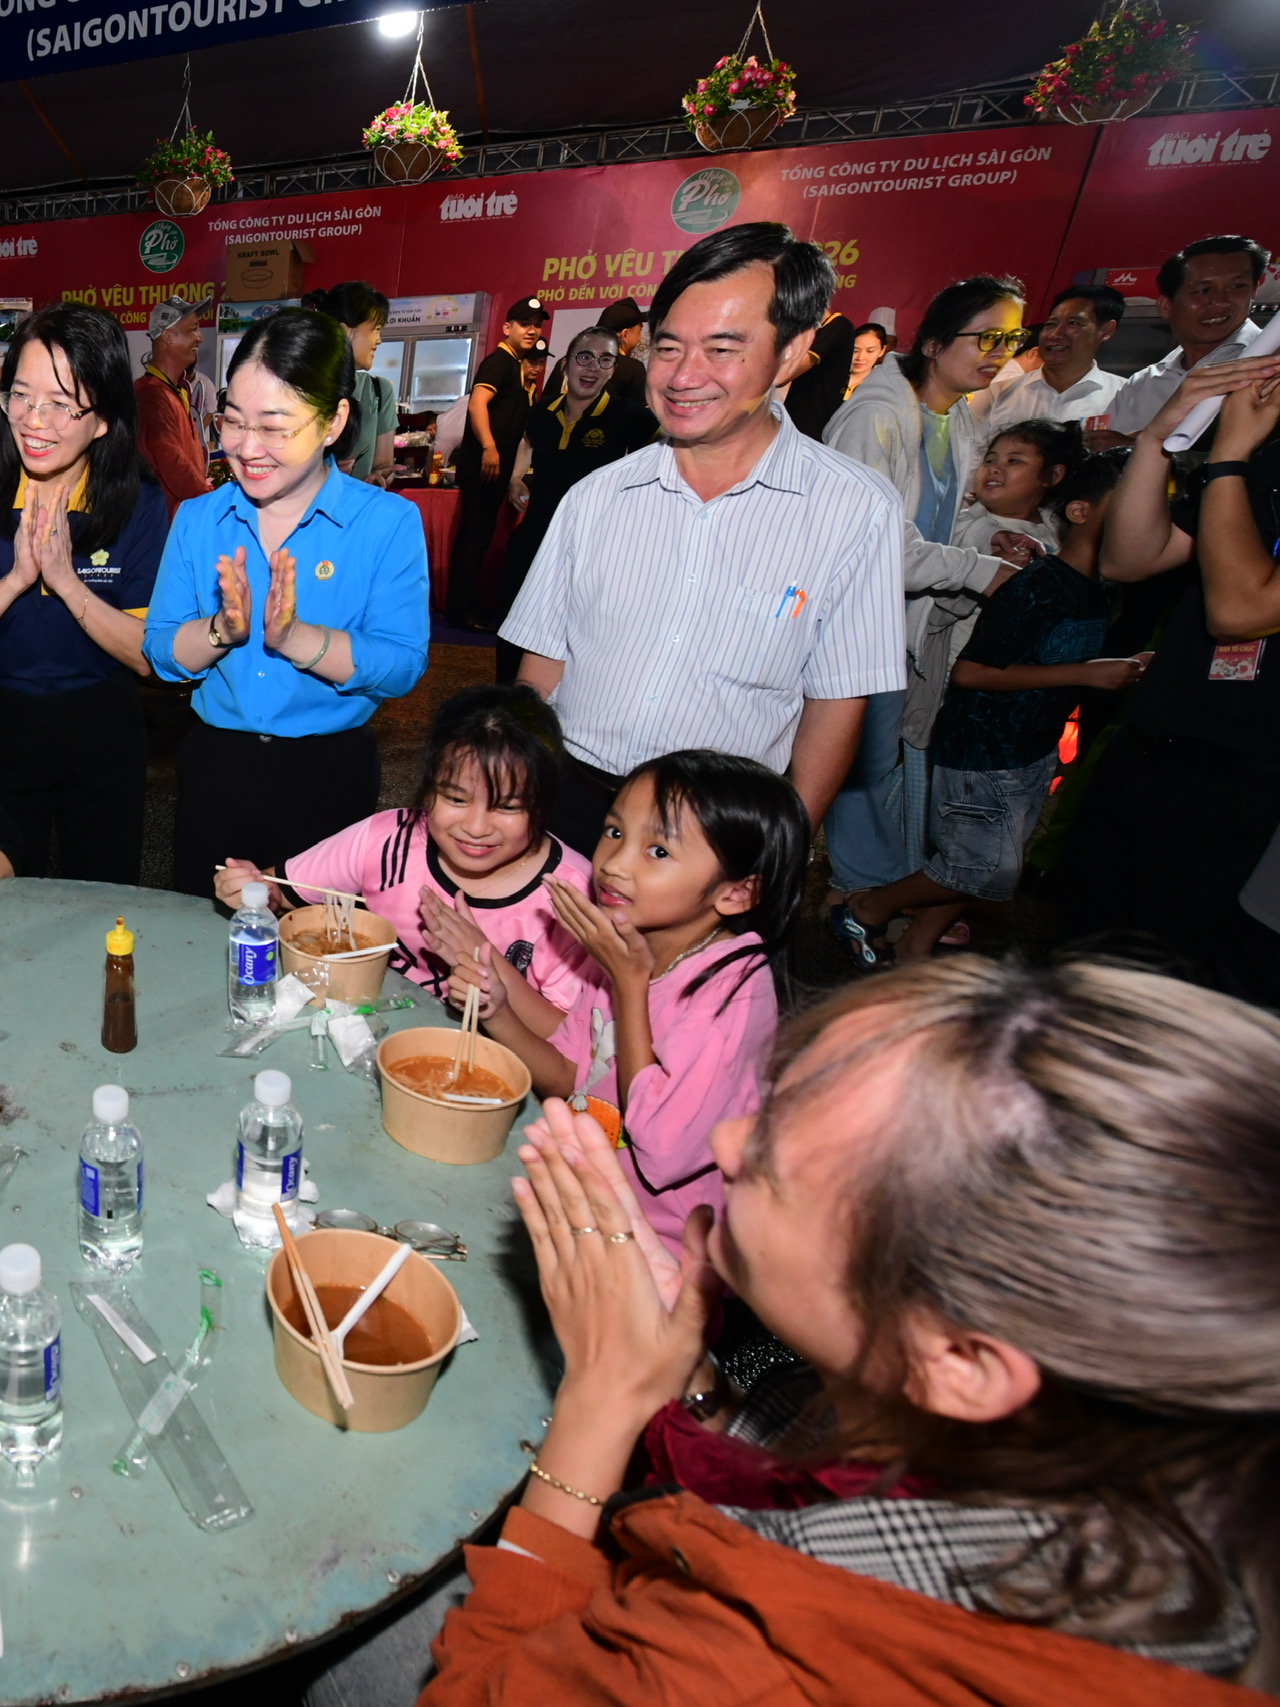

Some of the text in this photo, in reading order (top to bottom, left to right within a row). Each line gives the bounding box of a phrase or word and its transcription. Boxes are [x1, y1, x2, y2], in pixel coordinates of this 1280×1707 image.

[1148, 127, 1271, 166] tuổi trẻ
[781, 145, 1052, 181] TỔNG CÔNG TY DU LỊCH SÀI GÒN
[677, 179, 733, 212] Phở
[802, 169, 1018, 199] (SAIGONTOURIST GROUP)
[208, 204, 382, 232] TỔNG CÔNG TY DU LỊCH SÀI GÒN
[439, 190, 518, 220] tuổi trẻ
[16, 236, 38, 256] trẻ
[144, 230, 179, 254] Phở
[224, 224, 362, 246] (SAIGONTOURIST GROUP)
[260, 249, 279, 257] BOWL
[543, 249, 597, 281] PHỞ
[605, 248, 654, 278] YÊU
[101, 283, 134, 307] YÊU
[139, 280, 215, 304] THƯƠNG
[537, 285, 565, 302] PHỞ
[600, 283, 624, 299] VỚI
[627, 281, 659, 297] CÔN
[120, 310, 147, 324] CÔNG
[397, 314, 421, 323] KHUẨN
[243, 946, 257, 985] Ocany
[286, 1157, 297, 1192] Ocany
